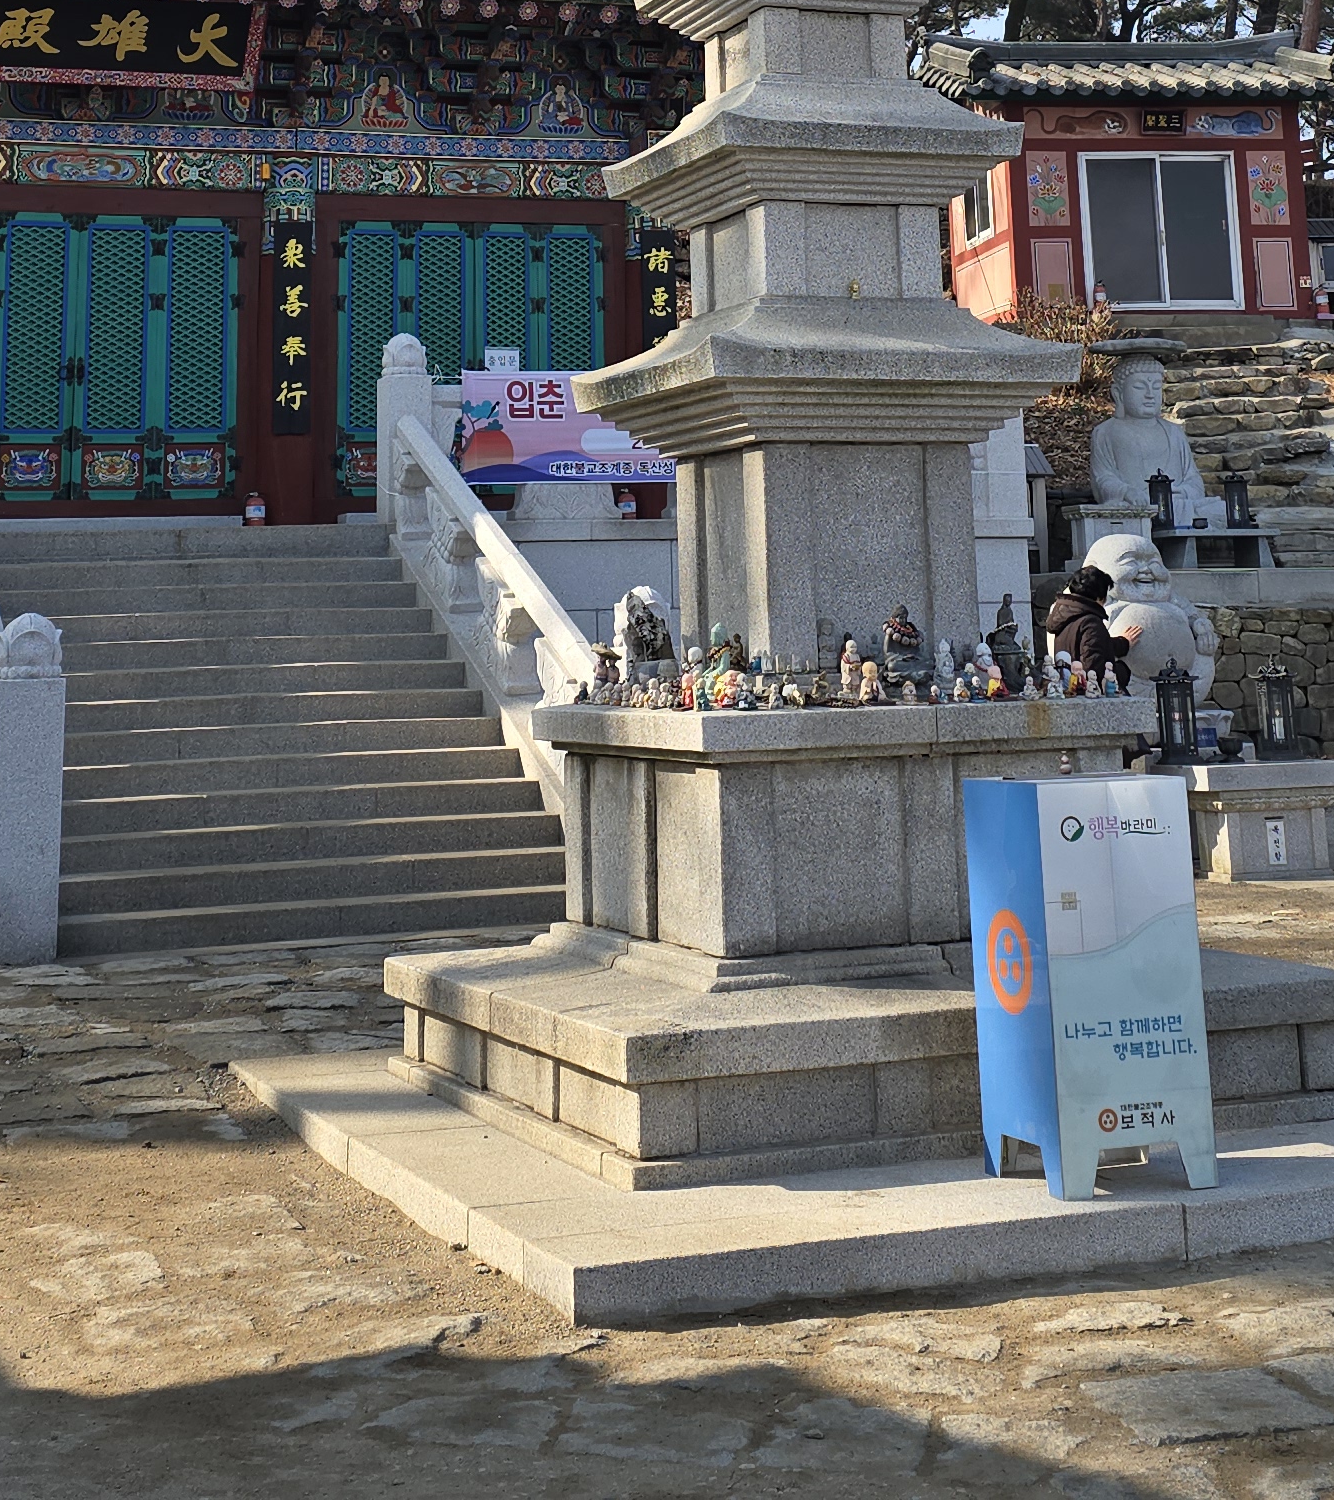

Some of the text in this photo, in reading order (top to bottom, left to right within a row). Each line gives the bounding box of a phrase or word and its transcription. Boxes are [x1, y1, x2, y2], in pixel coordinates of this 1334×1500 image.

[487, 355, 517, 367] 출입문
[506, 380, 565, 420] 입춘
[550, 460, 674, 475] 대한불교조계종 독산성
[1064, 1014, 1184, 1040] 나누고 함께하면
[1112, 1038, 1199, 1061] 행복합니다.
[1121, 1109, 1176, 1130] 보적사
